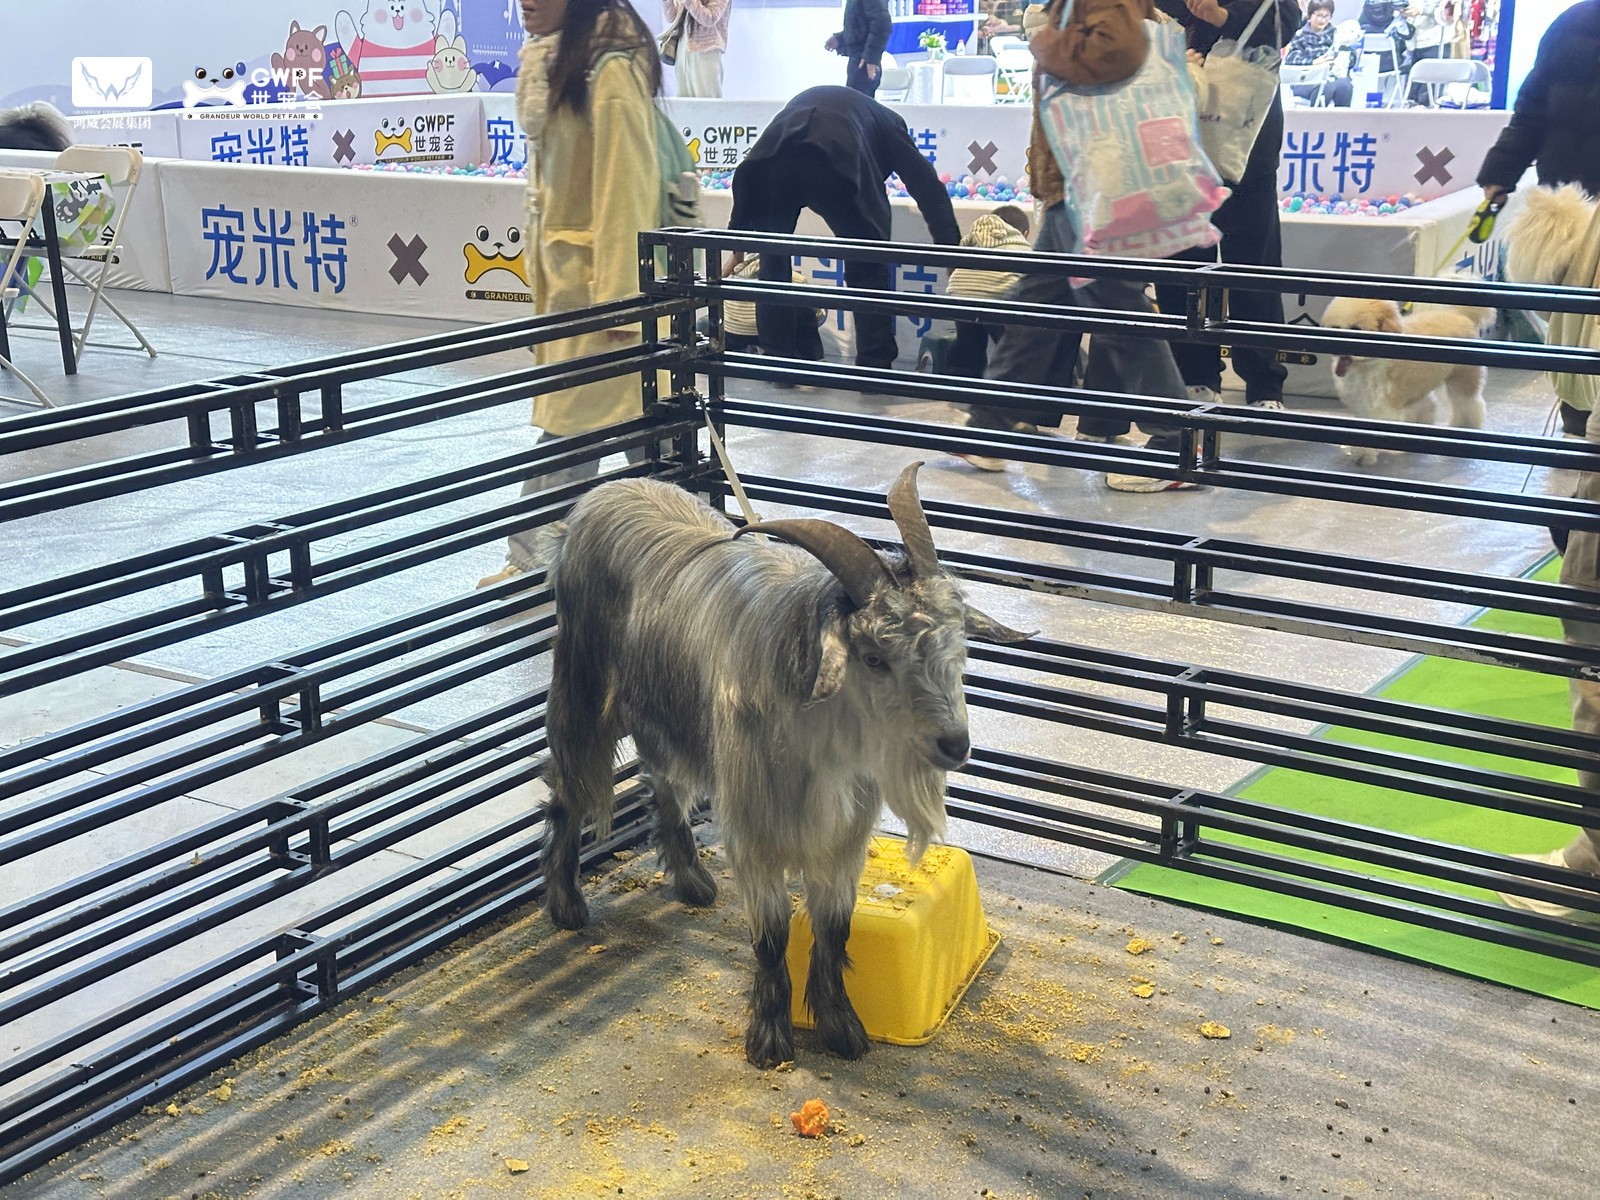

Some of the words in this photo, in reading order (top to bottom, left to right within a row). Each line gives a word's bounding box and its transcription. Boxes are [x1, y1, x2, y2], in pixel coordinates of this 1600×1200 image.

[414, 114, 455, 133] GWPF
[414, 134, 455, 153] 世宠会
[703, 126, 758, 144] GWPF
[201, 203, 348, 294] 宠米特
[484, 291, 531, 302] GRANDEUR
